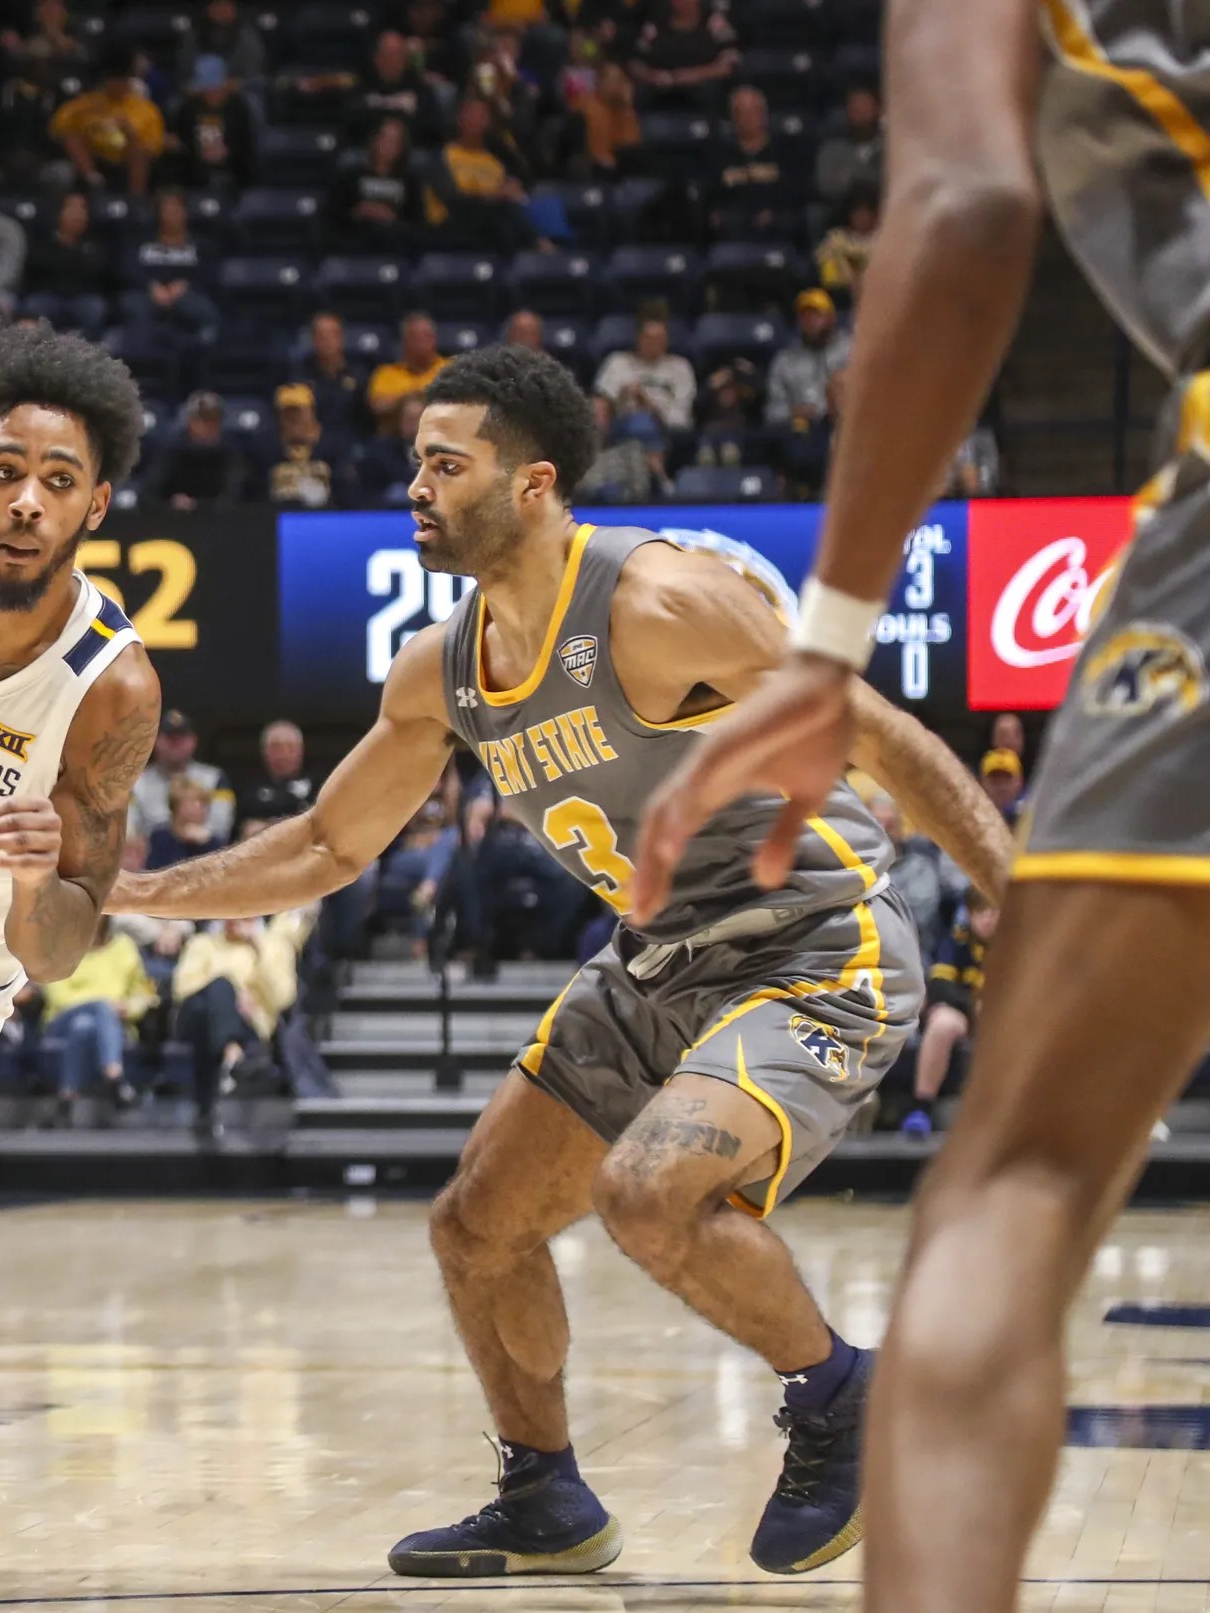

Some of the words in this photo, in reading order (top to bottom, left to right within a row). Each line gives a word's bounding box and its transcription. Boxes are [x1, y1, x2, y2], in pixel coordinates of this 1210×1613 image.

[905, 553, 934, 609] 3
[901, 642, 928, 699] 0
[526, 705, 619, 782] STATE
[543, 796, 637, 915] 3
